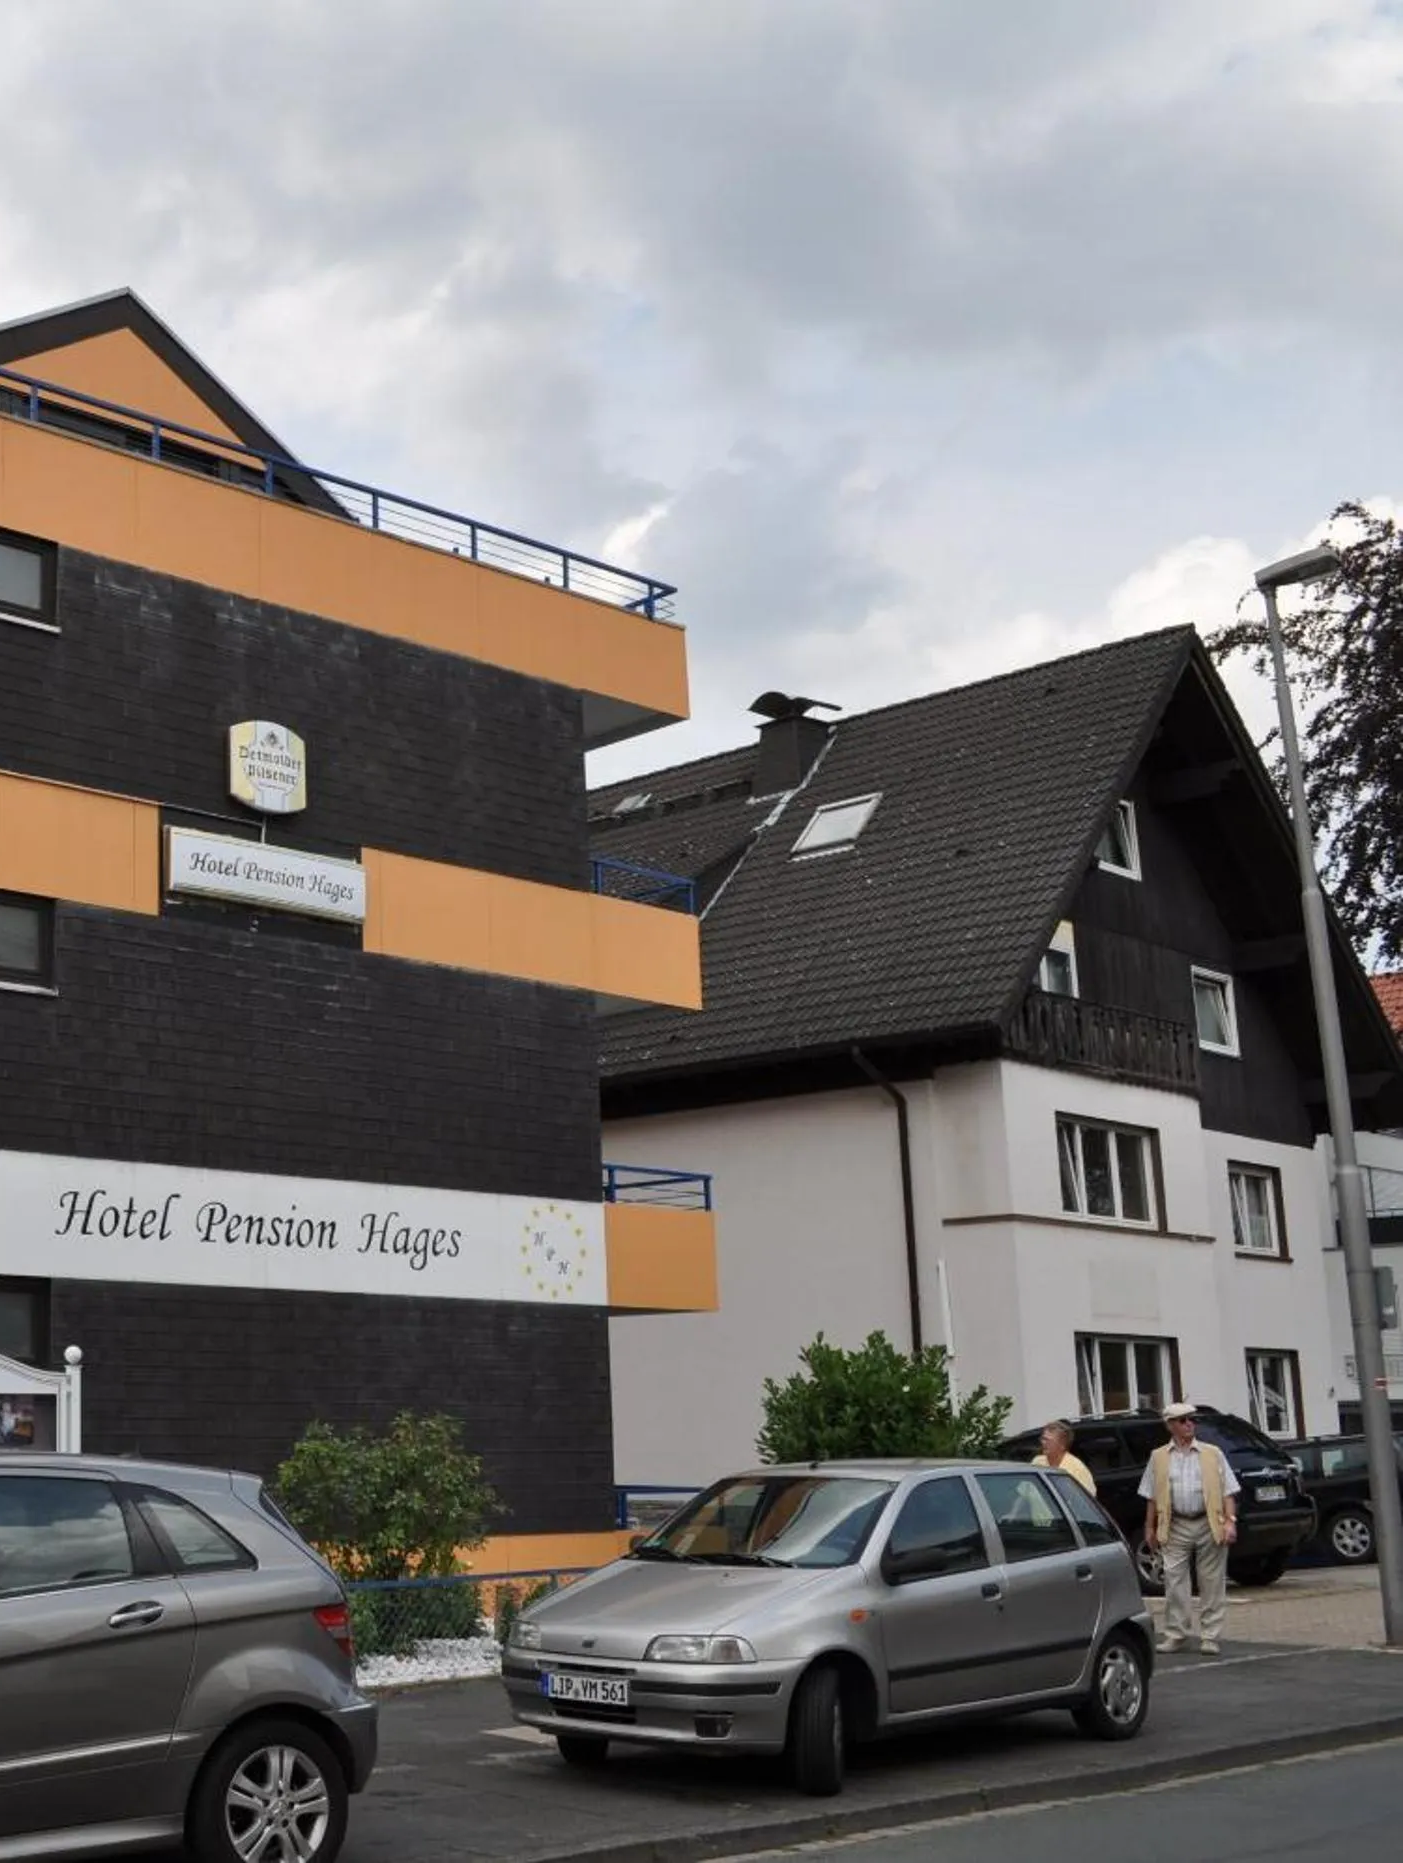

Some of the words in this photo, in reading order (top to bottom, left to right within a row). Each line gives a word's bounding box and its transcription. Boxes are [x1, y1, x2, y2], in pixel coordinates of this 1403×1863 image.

[239, 745, 301, 771] Detmolder
[189, 852, 239, 876] Hotel
[243, 862, 305, 889] Pension
[308, 873, 354, 903] Hages
[54, 1189, 181, 1241] Hotel
[196, 1201, 339, 1249] Pension
[357, 1211, 462, 1271] Hages
[550, 1674, 574, 1696] LIP
[581, 1679, 598, 1699] YM
[602, 1681, 626, 1702] 561
